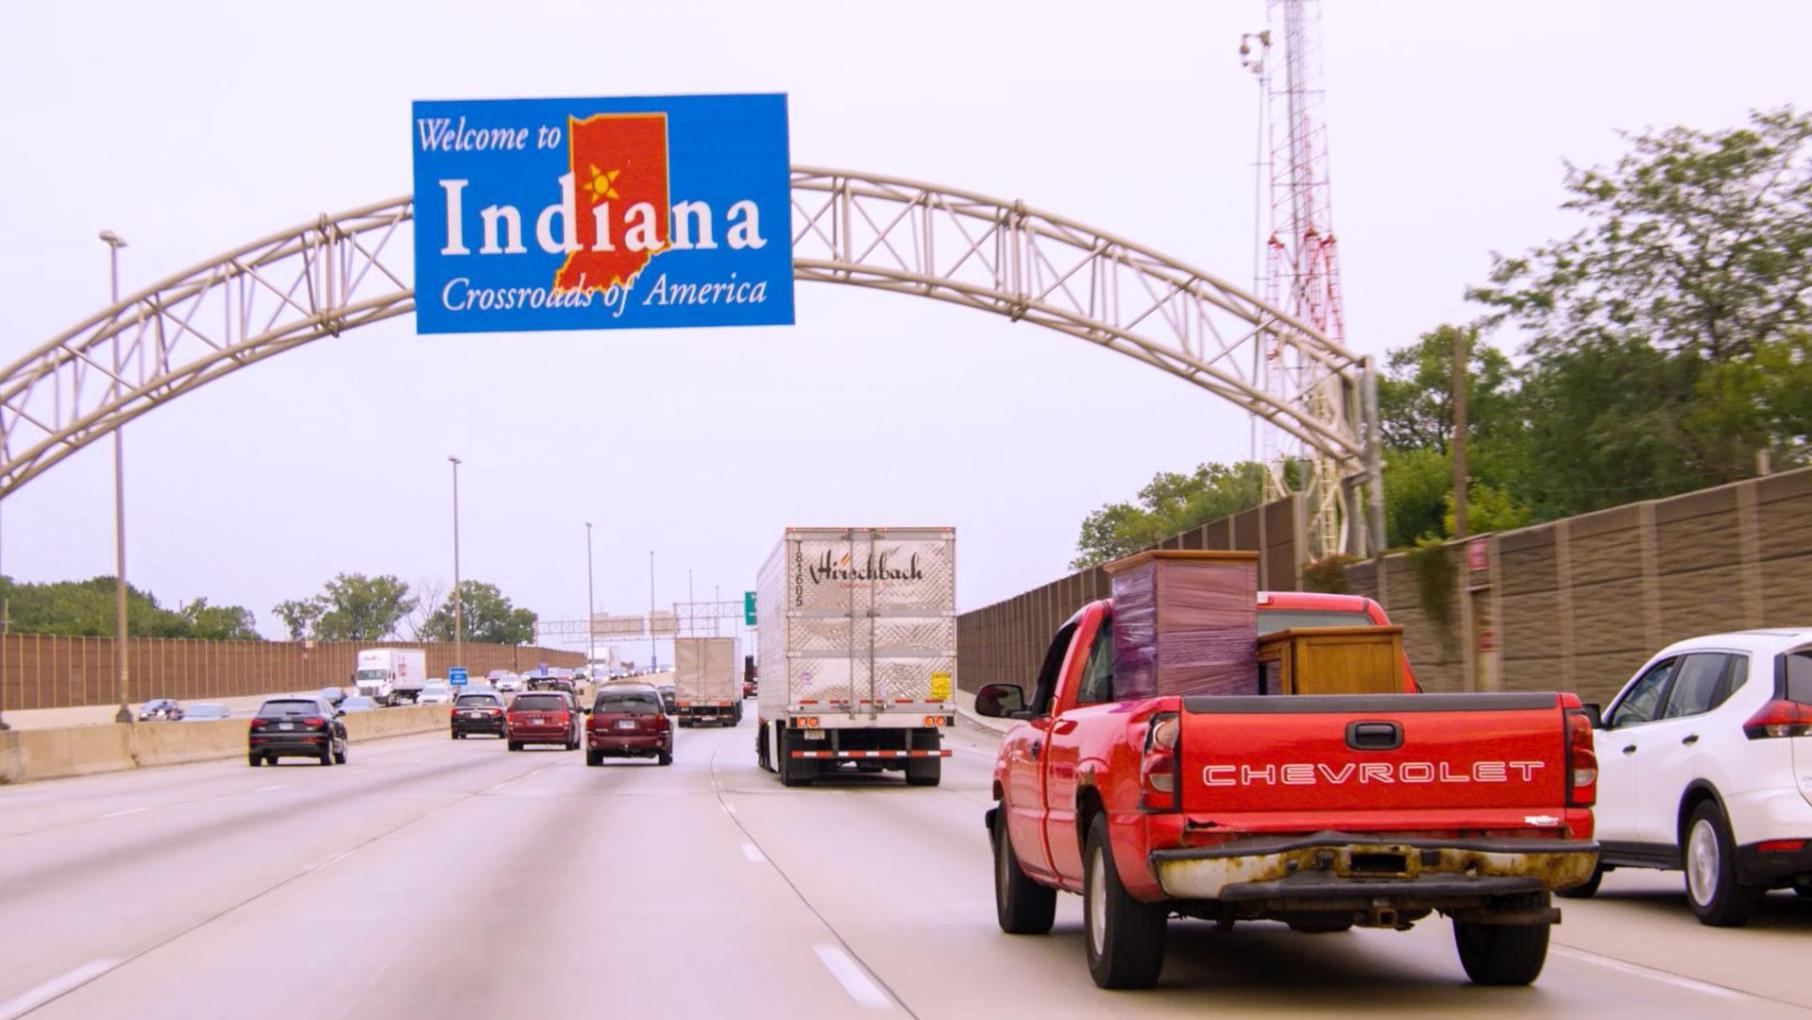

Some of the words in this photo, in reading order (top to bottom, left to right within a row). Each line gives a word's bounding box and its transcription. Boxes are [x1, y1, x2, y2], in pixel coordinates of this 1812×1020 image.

[417, 116, 529, 151] Welcome
[537, 123, 561, 150] to
[438, 170, 768, 256] Indiana
[442, 272, 595, 311] Crossroads
[603, 271, 638, 318] of
[643, 272, 767, 306] America
[809, 549, 923, 585] Hirschbach
[1202, 761, 1545, 787] CHEVROLET
